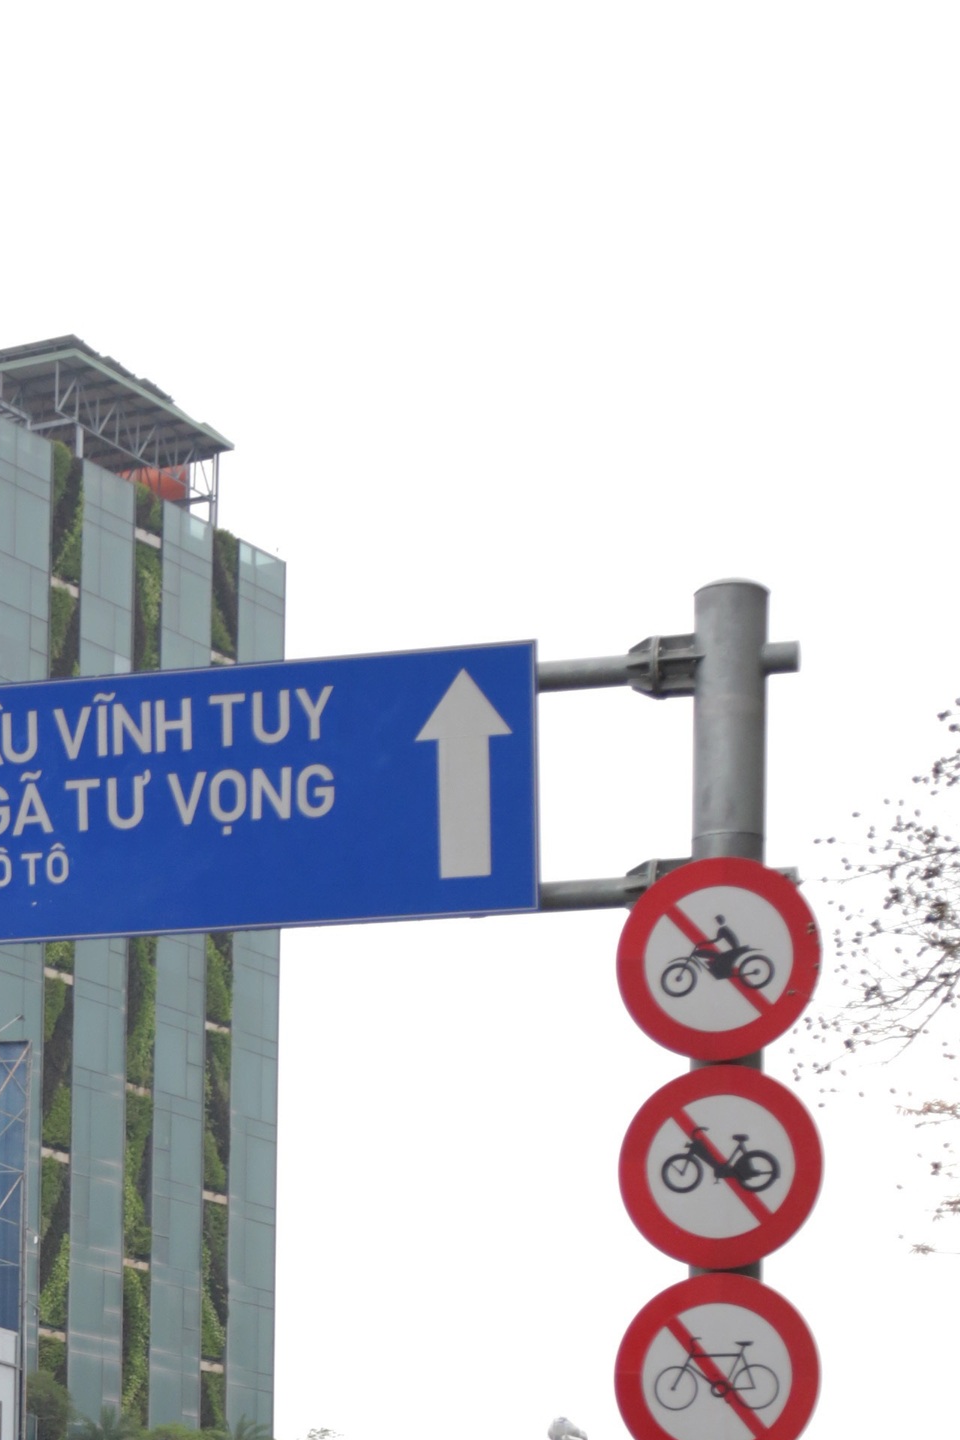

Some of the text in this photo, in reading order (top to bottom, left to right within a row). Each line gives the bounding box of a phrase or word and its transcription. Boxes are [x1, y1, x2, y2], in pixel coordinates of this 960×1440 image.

[53, 692, 192, 760] VĨNH
[209, 685, 334, 747] TUY
[65, 769, 151, 833] TƯ
[168, 763, 335, 836] VỌNG
[21, 842, 69, 886] TÔ
